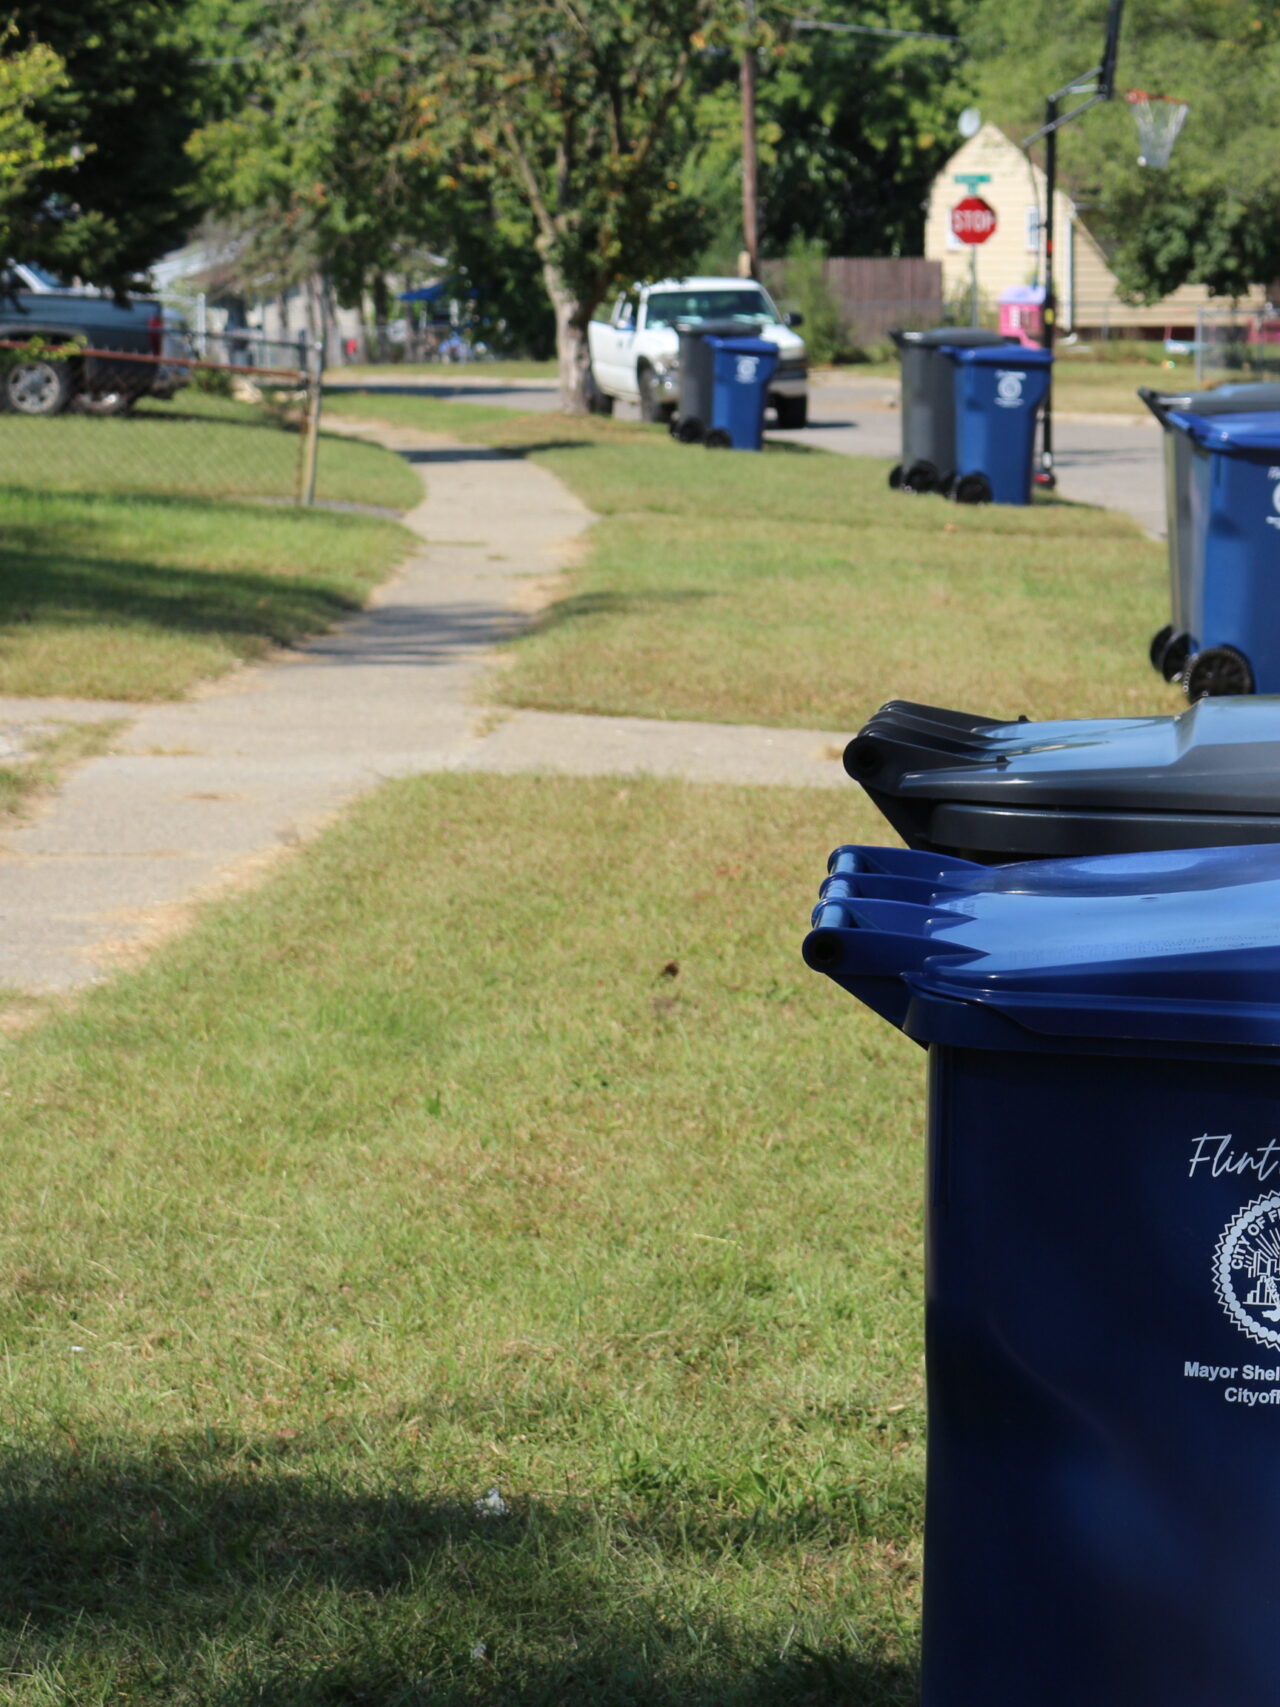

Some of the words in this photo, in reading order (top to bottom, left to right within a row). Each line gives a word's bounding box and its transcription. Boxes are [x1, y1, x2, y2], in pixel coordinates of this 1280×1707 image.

[953, 209, 995, 233] STOP
[1231, 1235, 1249, 1270] CITY
[1247, 1216, 1266, 1236] OF
[1184, 1361, 1239, 1381] Mayor
